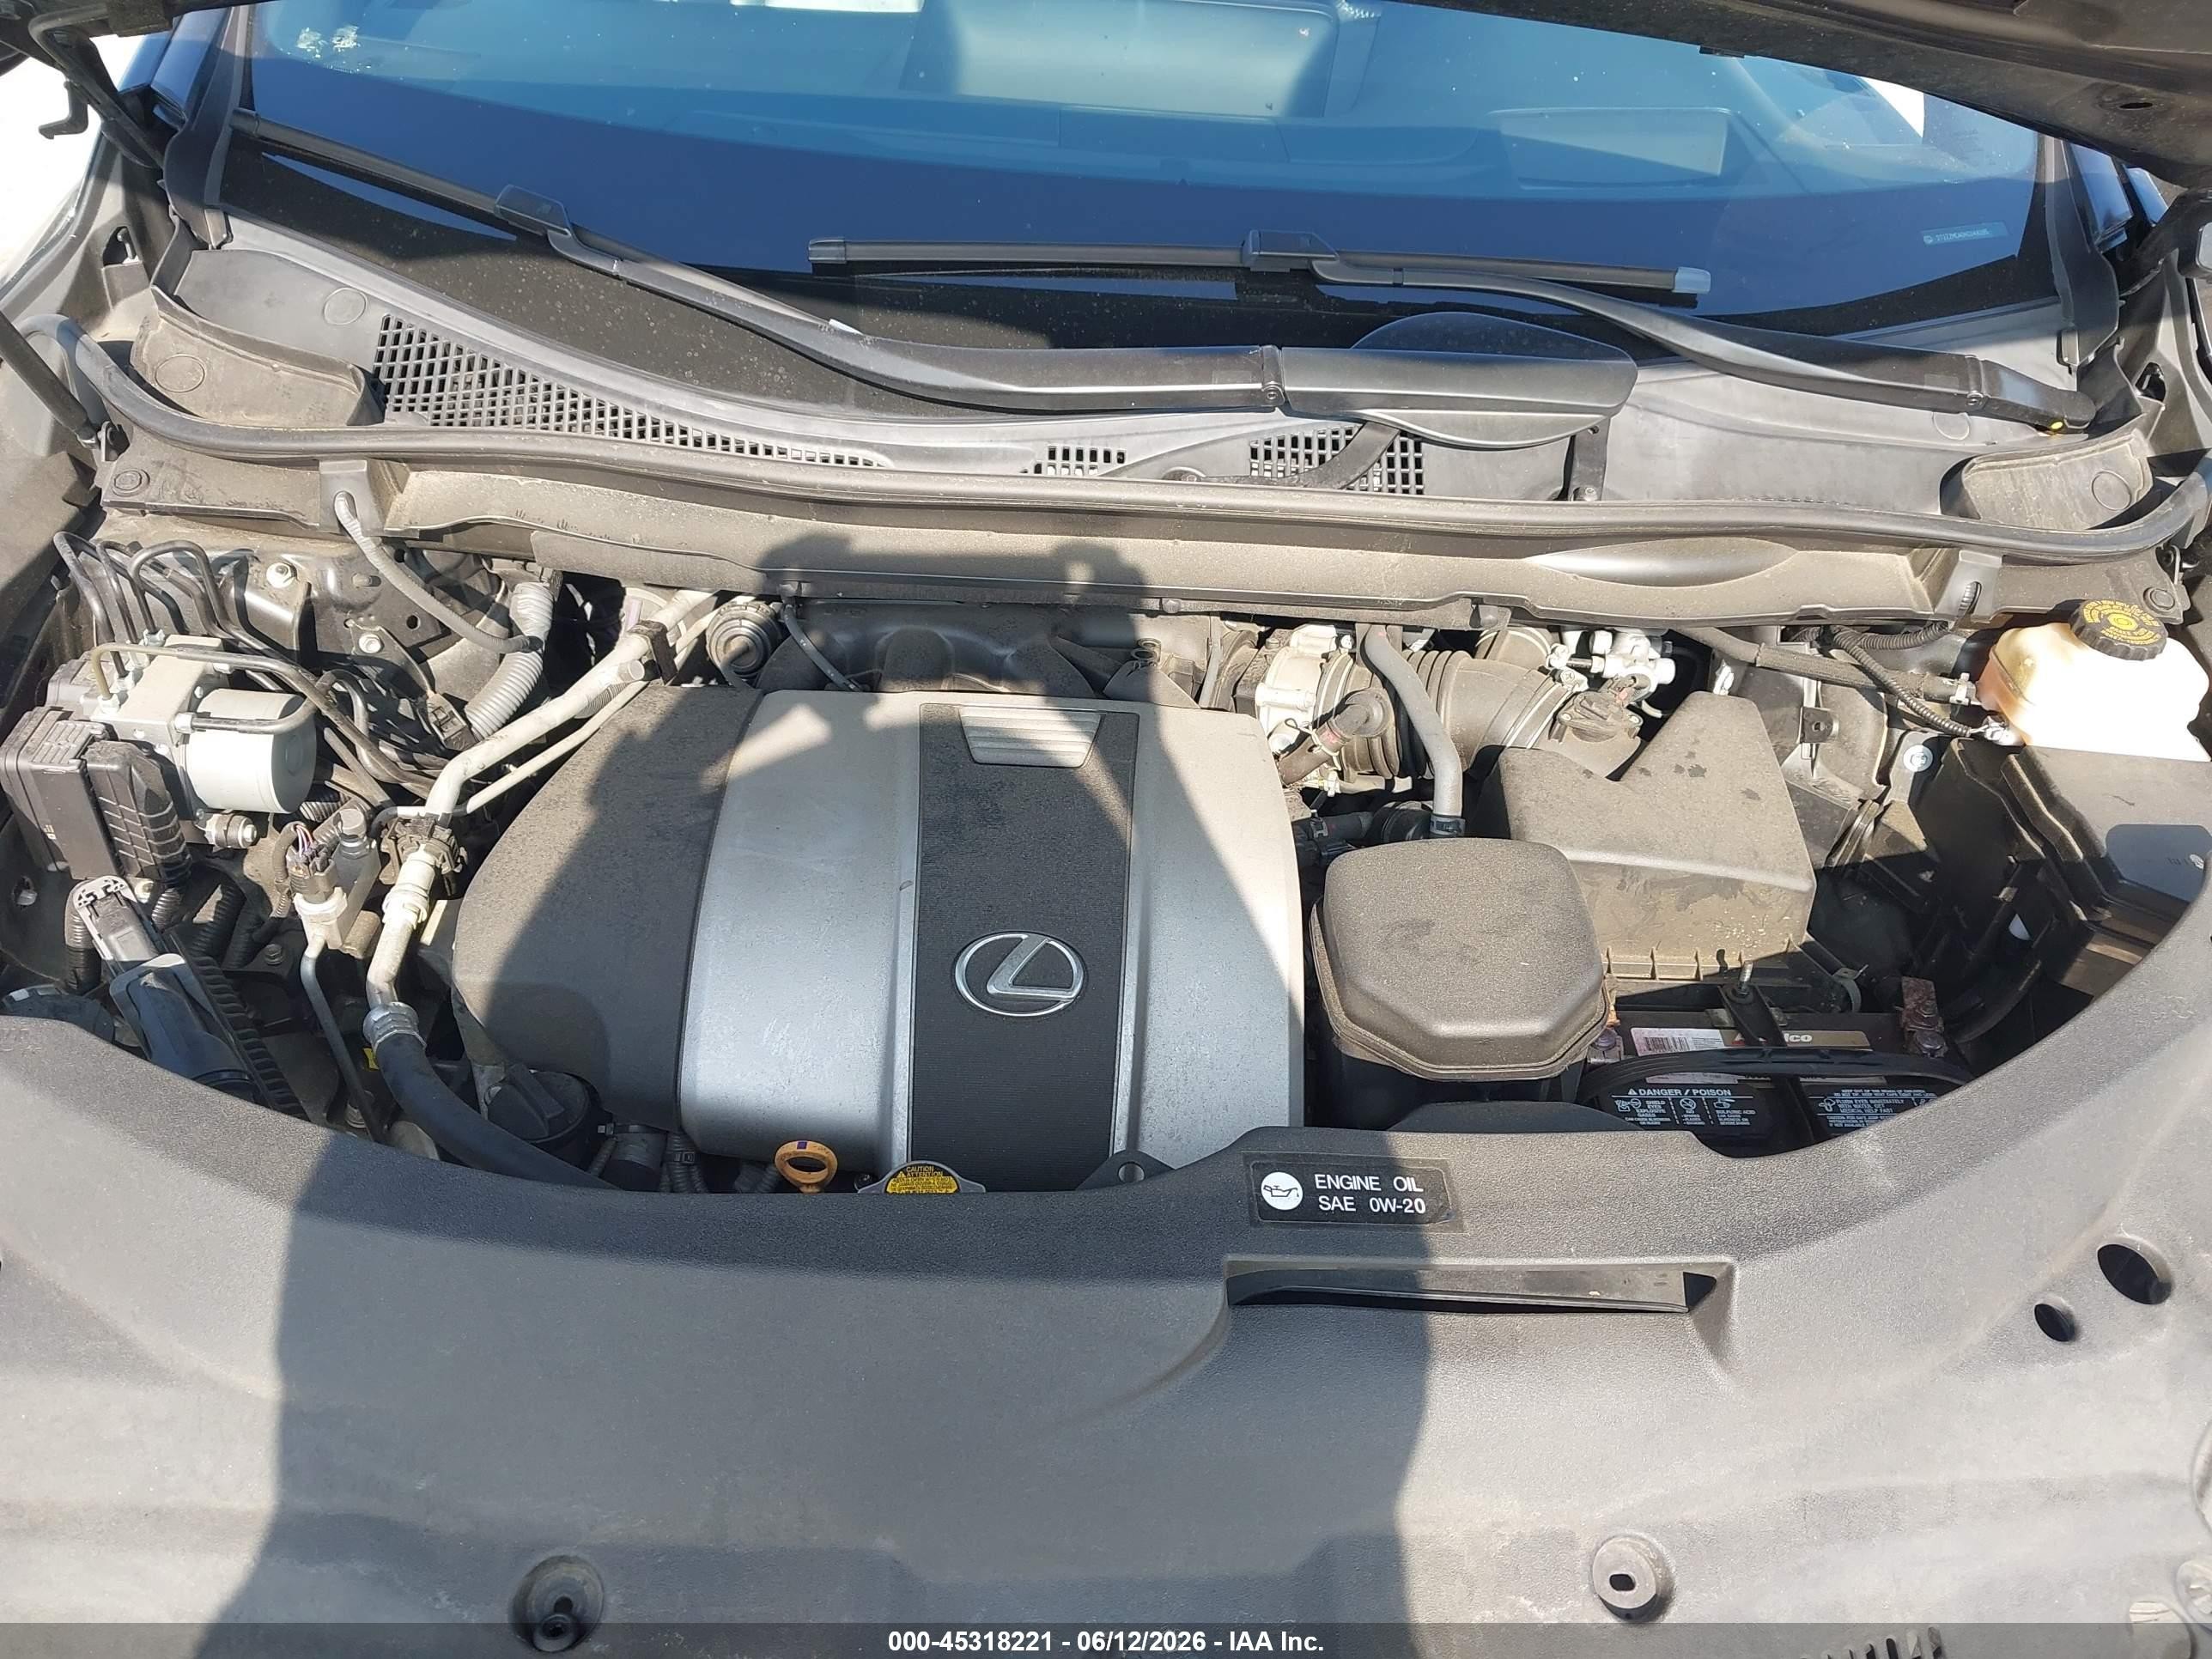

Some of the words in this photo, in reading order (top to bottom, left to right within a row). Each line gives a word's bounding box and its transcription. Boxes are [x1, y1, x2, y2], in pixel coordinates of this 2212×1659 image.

[1314, 1174, 1382, 1191] ENGINE
[1393, 1176, 1424, 1192] OIL
[1318, 1195, 1357, 1212] SAE
[1370, 1198, 1426, 1214] 0W-20
